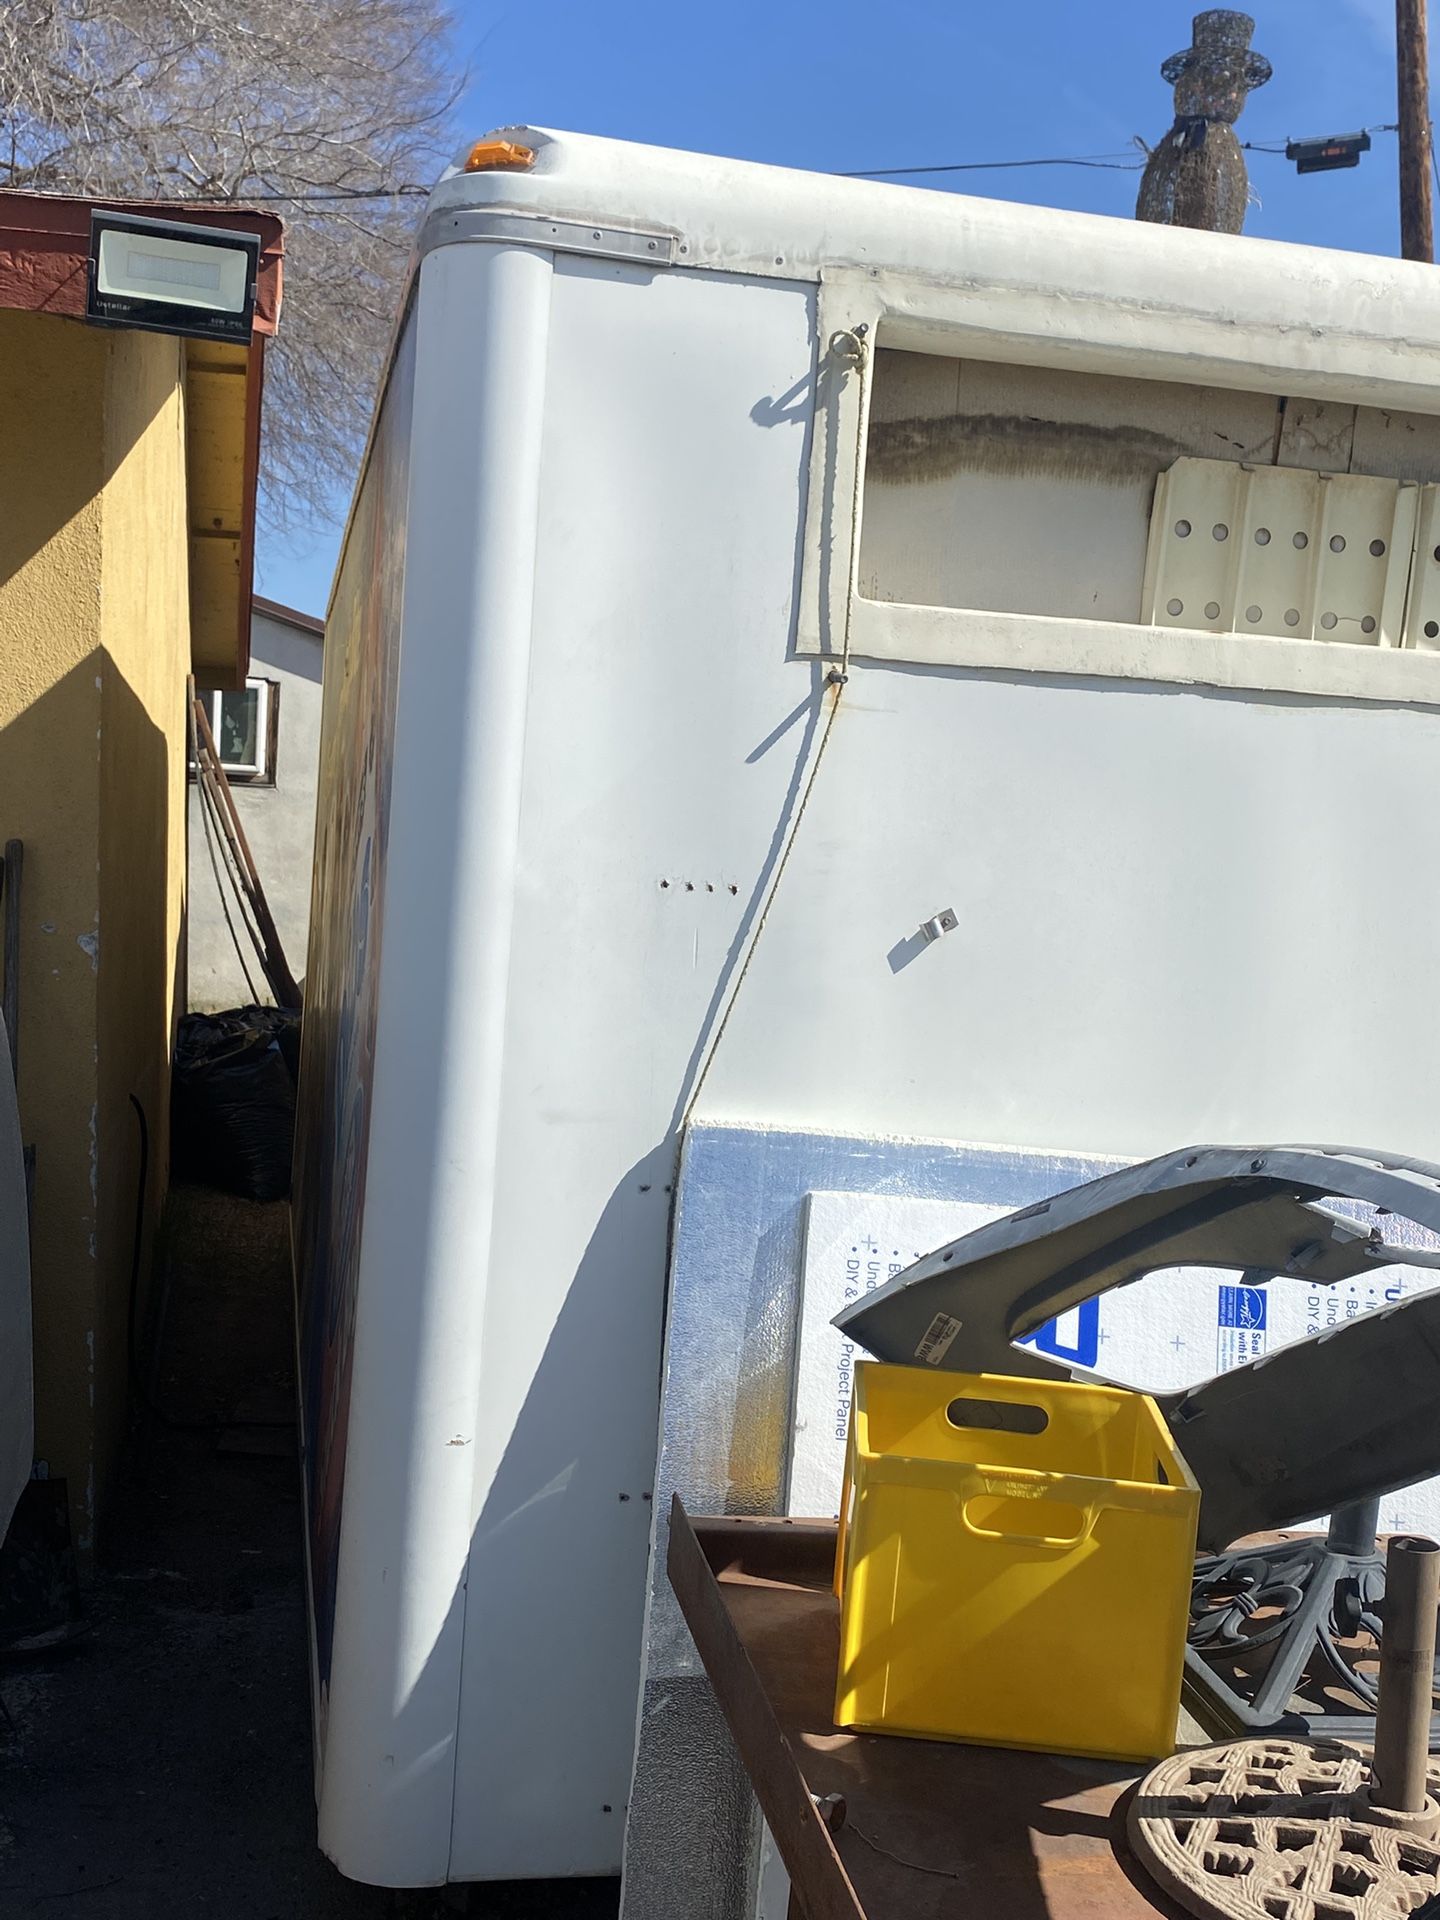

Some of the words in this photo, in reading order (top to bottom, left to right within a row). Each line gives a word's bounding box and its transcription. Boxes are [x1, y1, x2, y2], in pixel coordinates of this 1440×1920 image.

[846, 1259, 860, 1284] DIY
[844, 1287, 859, 1299] &
[1307, 1296, 1320, 1321] DIY
[1238, 1331, 1248, 1354] with
[1251, 1332, 1262, 1355] Seal
[837, 1343, 855, 1395] Project
[835, 1400, 851, 1441] Panel
